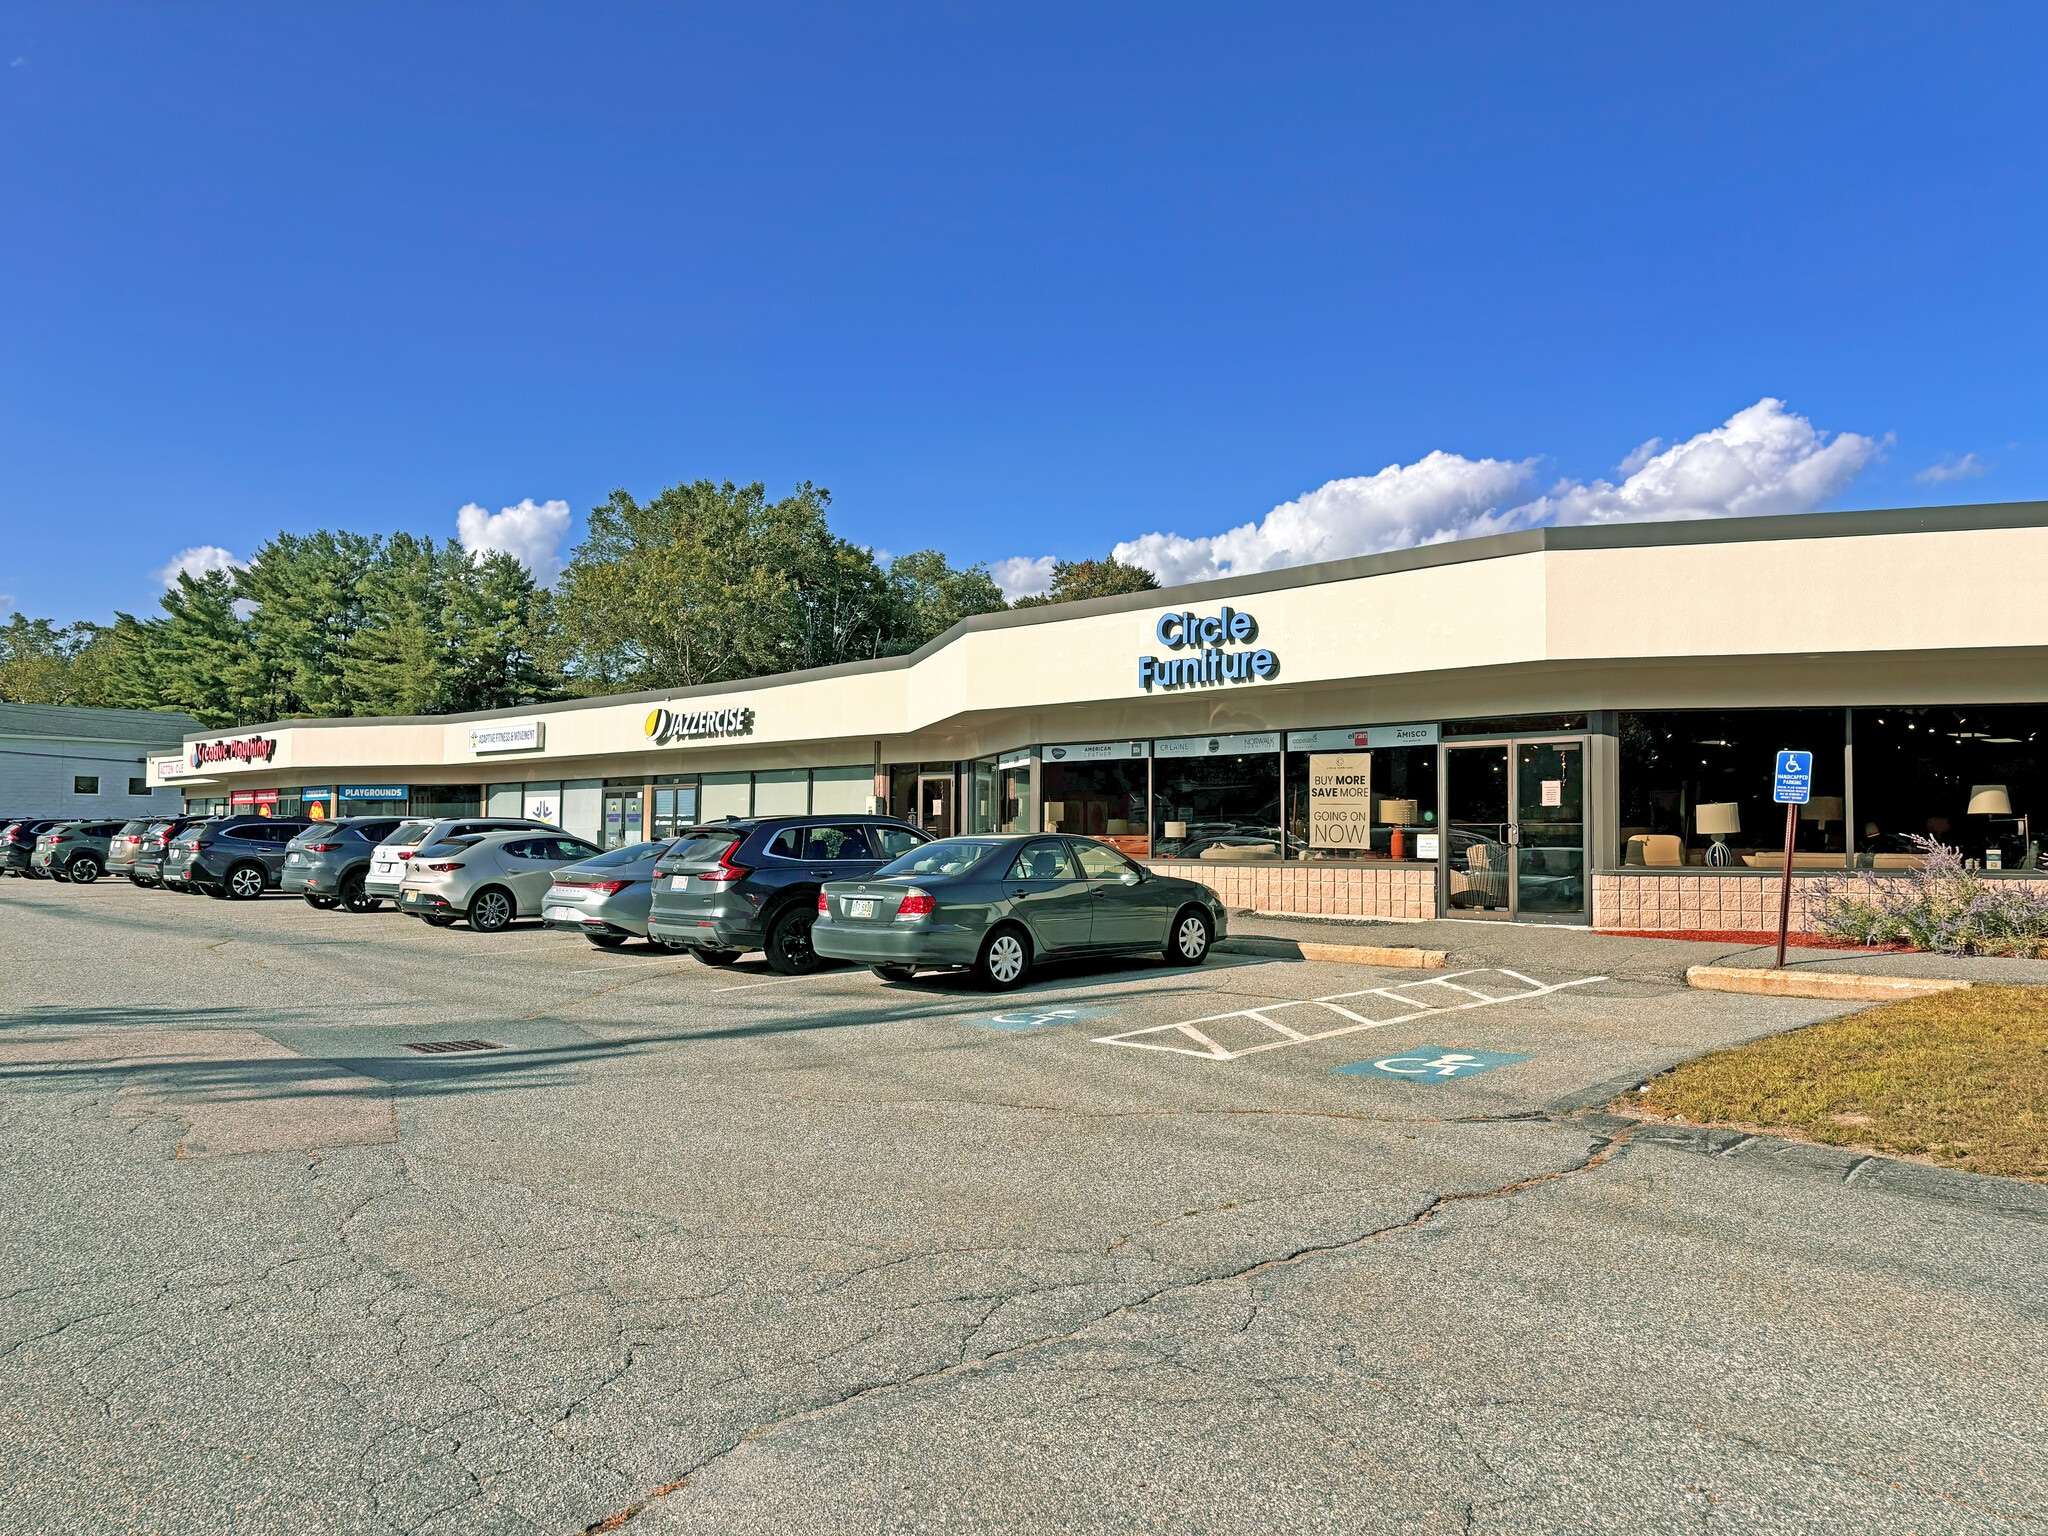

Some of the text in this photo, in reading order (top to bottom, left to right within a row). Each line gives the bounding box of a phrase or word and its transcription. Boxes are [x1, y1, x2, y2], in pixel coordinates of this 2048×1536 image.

[1156, 606, 1253, 646] Circle
[1138, 648, 1274, 688] Furniture
[664, 707, 746, 738] JAZZERCISE
[479, 733, 495, 744] ADAPTIVE
[496, 731, 510, 742] FITNESS
[514, 729, 535, 741] MOVEMENT
[1244, 736, 1275, 745] NORWALK
[198, 742, 228, 761] Creative
[1314, 775, 1366, 785] BUY MORE
[345, 788, 402, 796] PLAYGROUNDS
[1311, 787, 1369, 797] SAVE MORE
[1314, 811, 1366, 821] GOING ON
[1315, 824, 1366, 844] NOW
